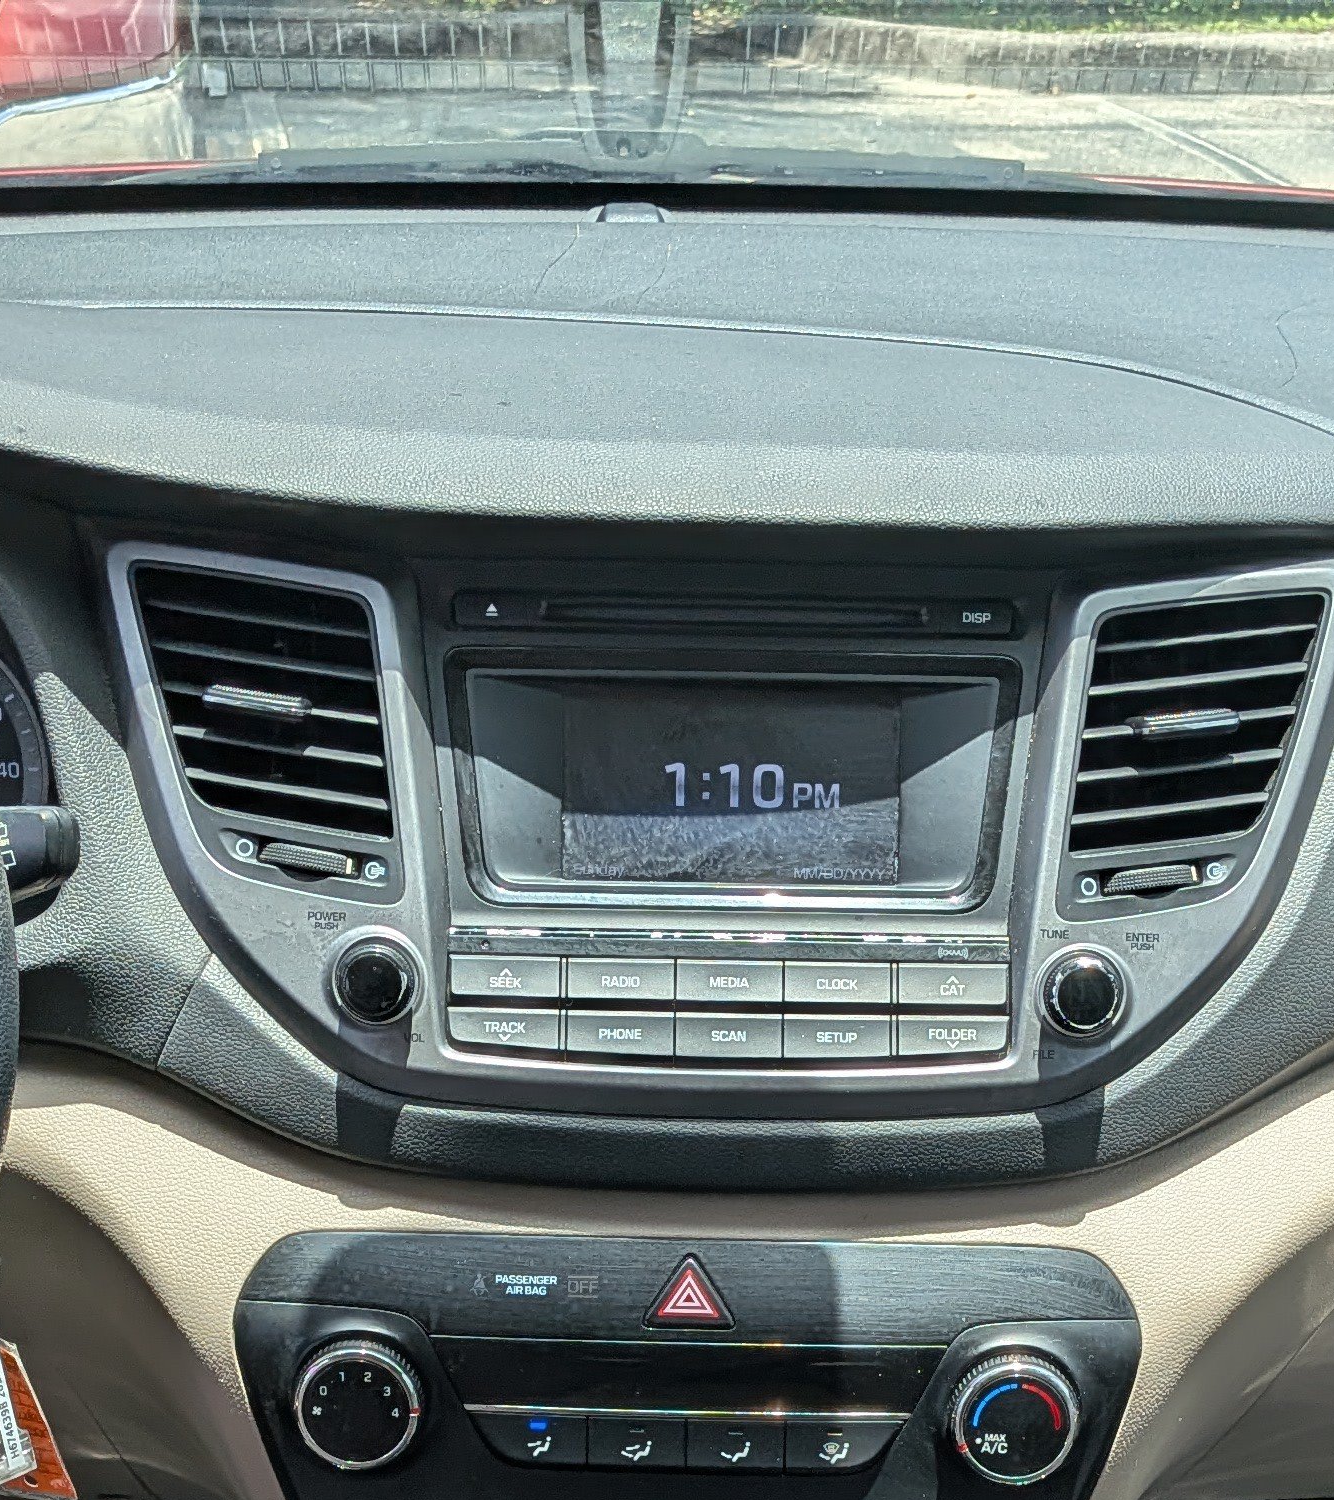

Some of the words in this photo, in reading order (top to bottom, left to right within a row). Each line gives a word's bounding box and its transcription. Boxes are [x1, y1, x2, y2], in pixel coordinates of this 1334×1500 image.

[962, 612, 991, 624] DISP
[665, 762, 785, 809] 1:10
[793, 783, 841, 809] PM
[307, 911, 347, 923] POWER
[314, 922, 339, 931] PUSH
[1040, 929, 1069, 941] TUNE
[1125, 932, 1160, 943] ENTER
[1130, 943, 1155, 952] PUSH
[489, 976, 522, 989] SEEK
[601, 976, 641, 989] RADIO
[709, 976, 750, 989] MEDIA
[816, 978, 858, 991] CLOCK
[939, 985, 966, 998] CAT
[484, 1021, 526, 1034] TRACK
[403, 1032, 426, 1044] VOL
[598, 1029, 642, 1041] PHONE
[711, 1030, 746, 1043] SCAN
[816, 1031, 858, 1044] SETUP
[928, 1028, 977, 1042] FOLDER
[1032, 1049, 1055, 1061] FILE
[495, 1274, 558, 1285] PASSENGER
[505, 1286, 523, 1295] AIR
[525, 1286, 547, 1296] BAG
[567, 1280, 599, 1294] OFF
[338, 1371, 346, 1382] 1
[363, 1371, 373, 1383] 2
[319, 1385, 328, 1396] 0
[383, 1386, 392, 1397] 3
[391, 1407, 399, 1418] 4
[984, 1433, 1007, 1442] MAX
[980, 1442, 1009, 1454] A/C
